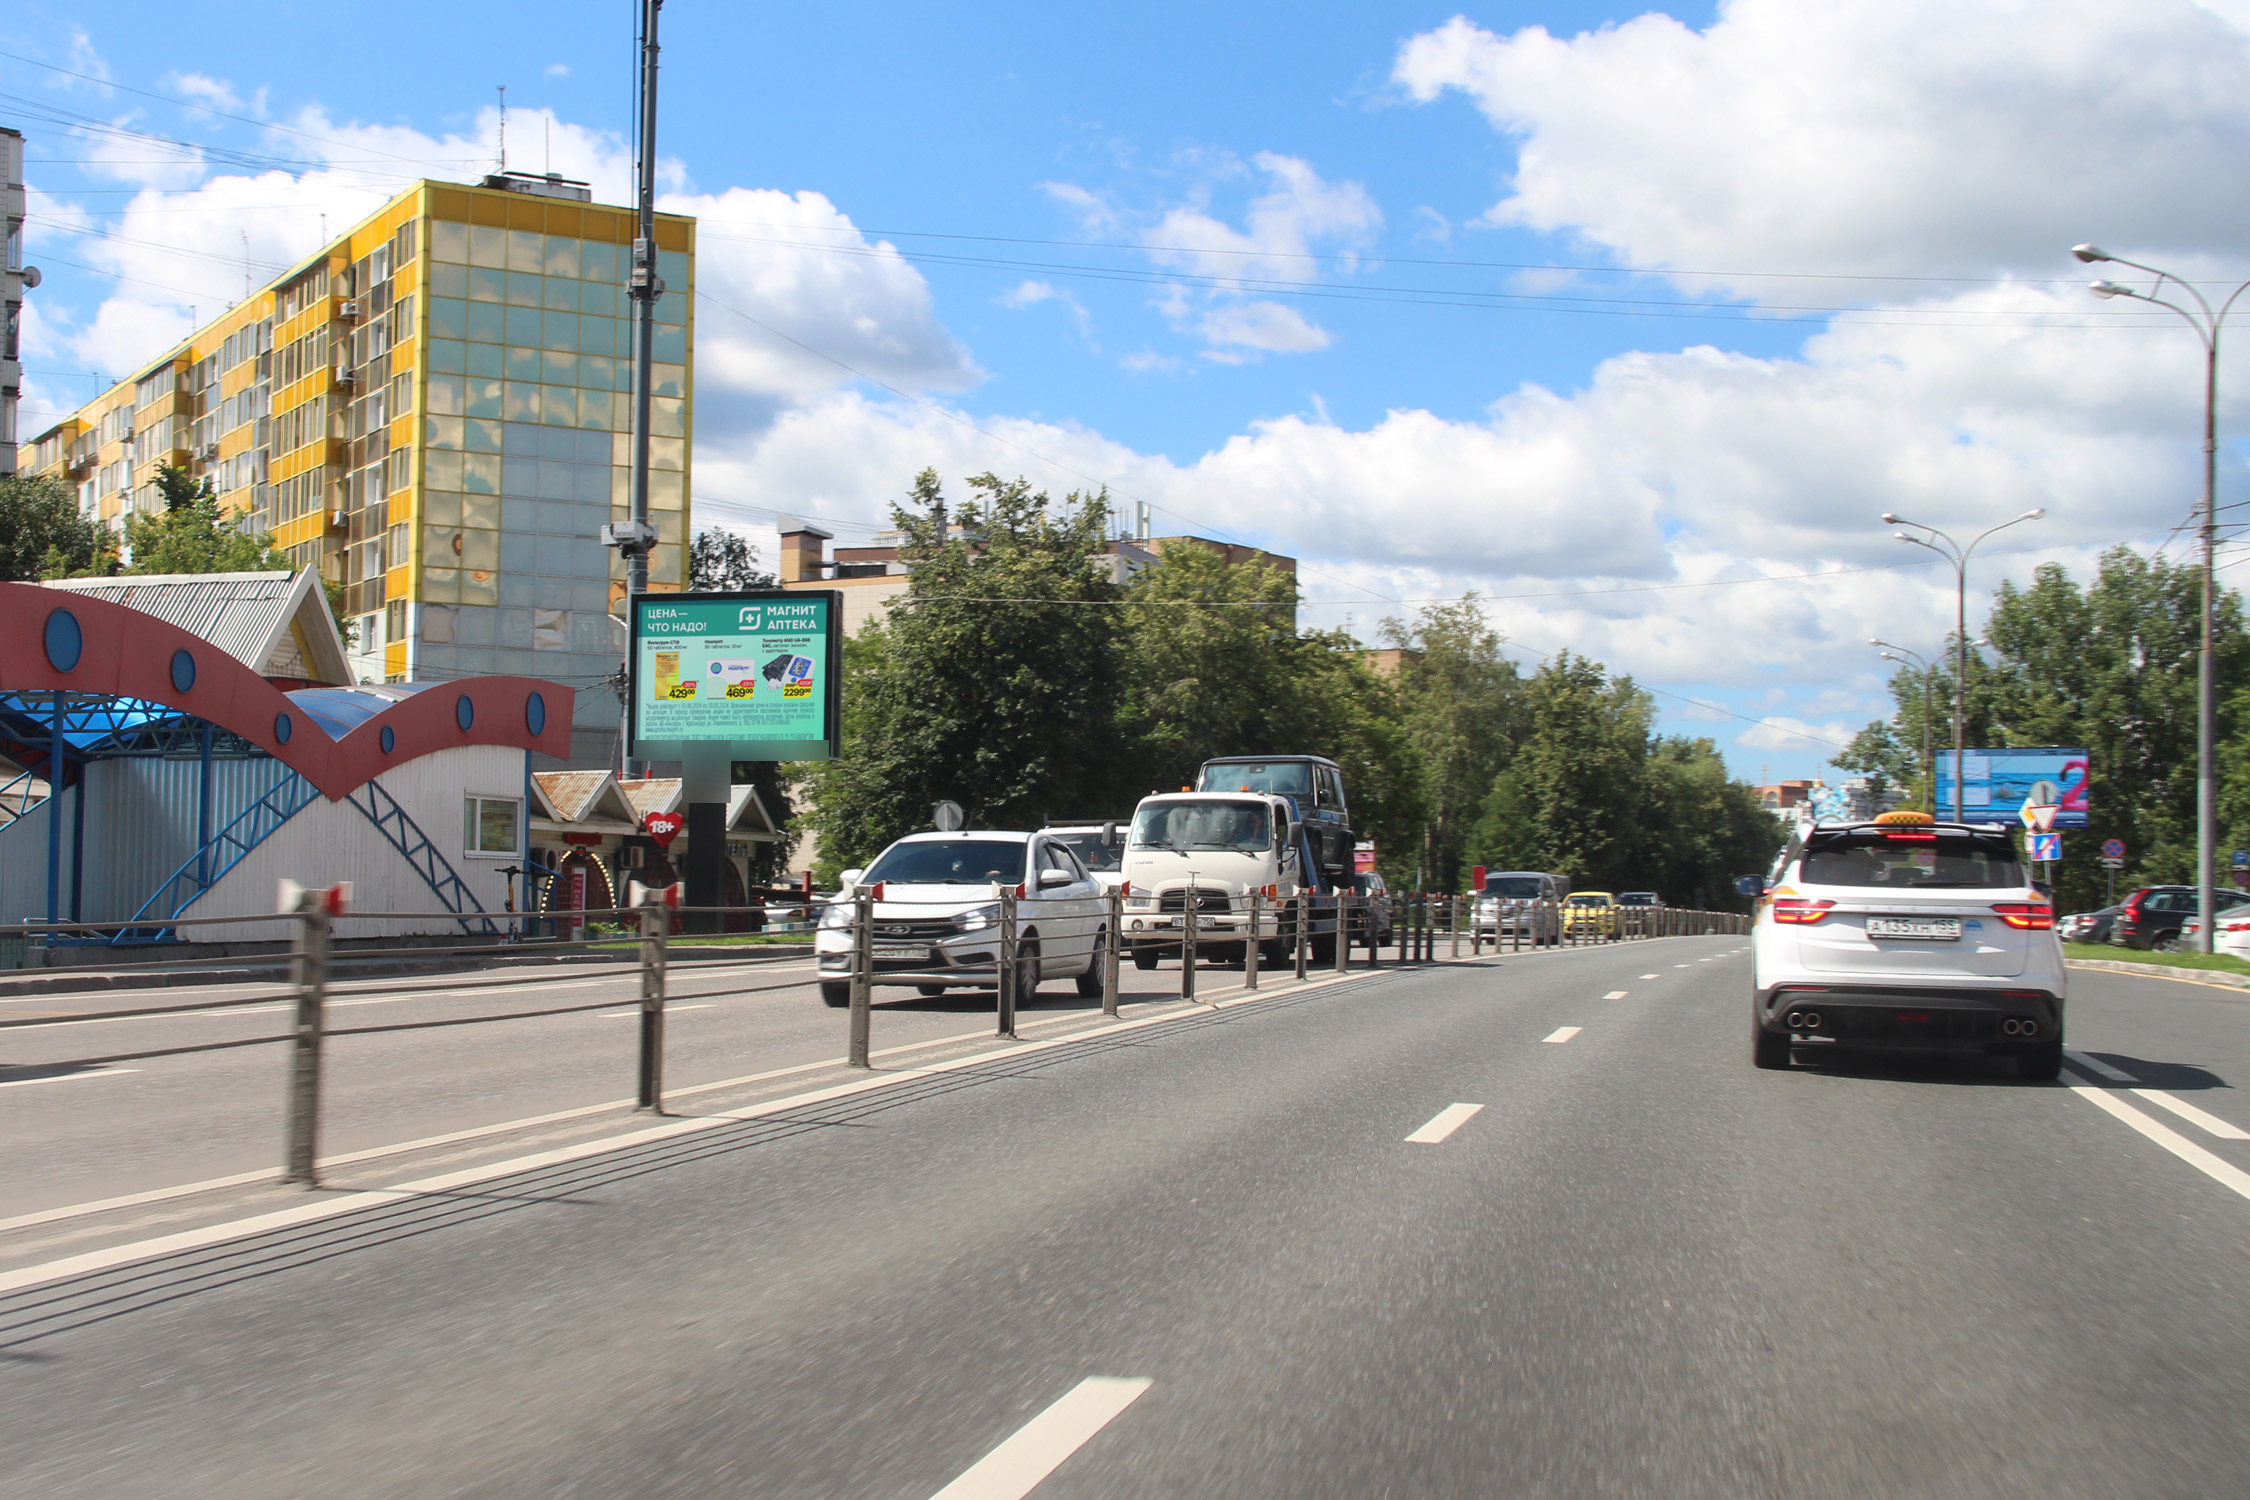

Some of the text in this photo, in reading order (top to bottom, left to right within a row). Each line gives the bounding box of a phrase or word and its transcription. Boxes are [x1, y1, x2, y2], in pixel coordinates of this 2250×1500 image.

[767, 605, 817, 616] МАГНИТ
[648, 622, 707, 633] ЧТО НАДО!
[767, 619, 817, 630] АПТЕКА
[649, 820, 675, 834] 18+
